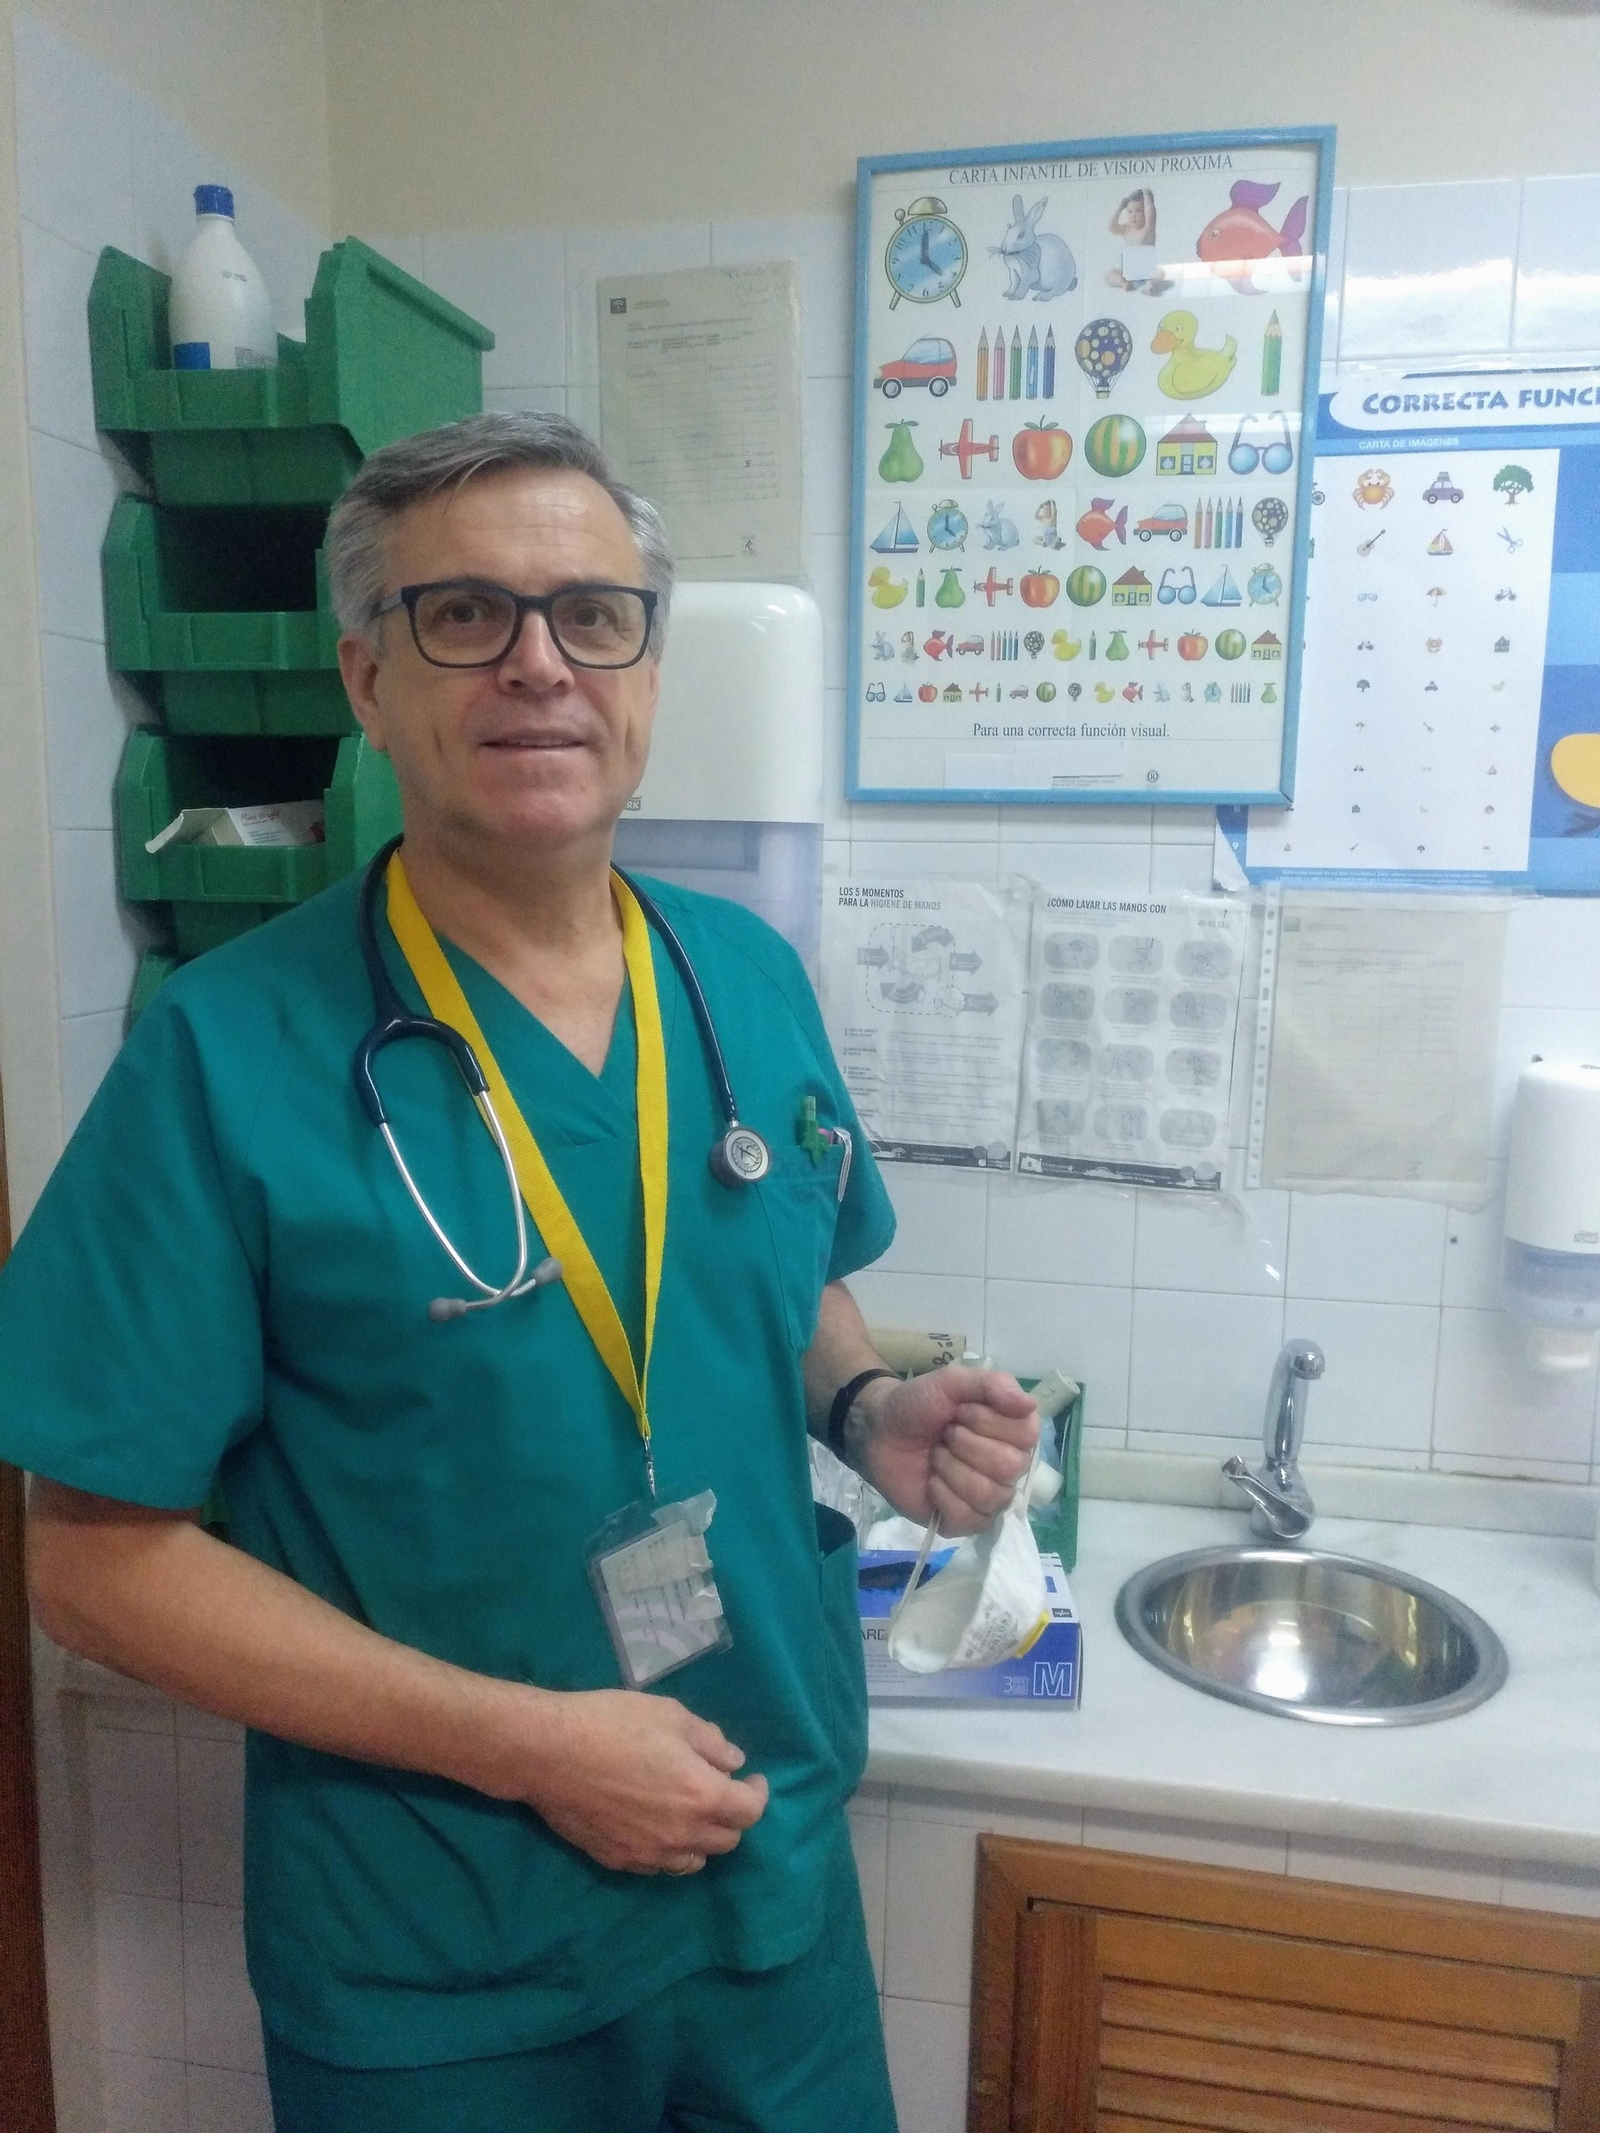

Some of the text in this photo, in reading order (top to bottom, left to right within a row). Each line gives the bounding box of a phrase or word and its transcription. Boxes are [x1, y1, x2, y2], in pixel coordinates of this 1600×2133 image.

[949, 155, 1233, 185] CARTA INFANTIL DE VISION PROXIMA
[1362, 391, 1509, 414] CORRECTA
[1358, 439, 1390, 450] CARTA
[1392, 438, 1406, 449] DE
[973, 723, 1170, 737] Para una correcta función visual.
[839, 887, 904, 898] LOS 5 MOMENTOS
[839, 897, 941, 910] PARA LA HIGIENE DE MANOS
[1047, 896, 1074, 908] ¿CÓMO
[1076, 901, 1101, 910] LAVAR
[1103, 902, 1117, 911] LAS
[1119, 903, 1148, 913] MANOS
[1149, 904, 1167, 914] CON
[1033, 1661, 1073, 1697] M
